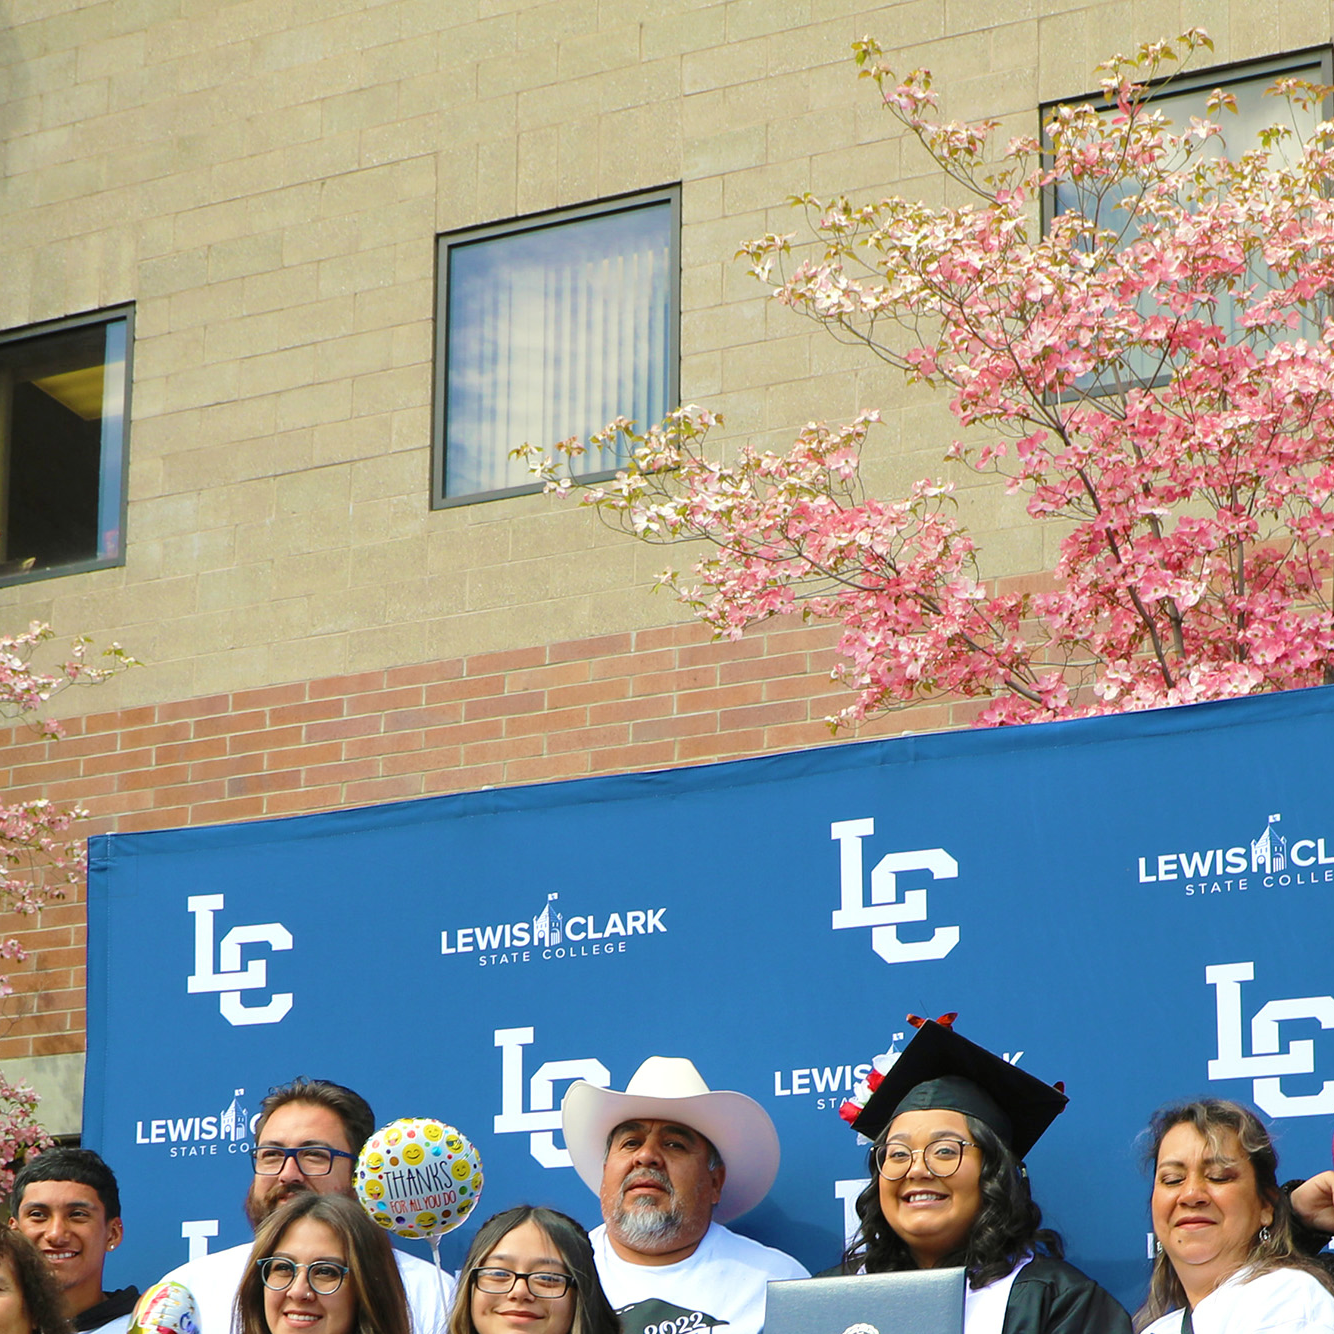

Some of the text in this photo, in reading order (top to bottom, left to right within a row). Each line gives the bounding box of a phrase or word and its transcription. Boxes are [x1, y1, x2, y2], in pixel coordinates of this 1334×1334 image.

[1139, 848, 1247, 885] LEWIS
[831, 818, 959, 963] LC
[1186, 879, 1246, 895] STATE
[442, 908, 666, 957] LEWIS CLARK
[188, 894, 292, 1025] LC
[480, 940, 625, 965] STATE COLLEGE
[136, 1116, 218, 1144] LEWIS
[170, 1144, 217, 1158] STATE
[384, 1161, 453, 1199] THANKS
[390, 1190, 457, 1214] FOR ALL YOU DO
